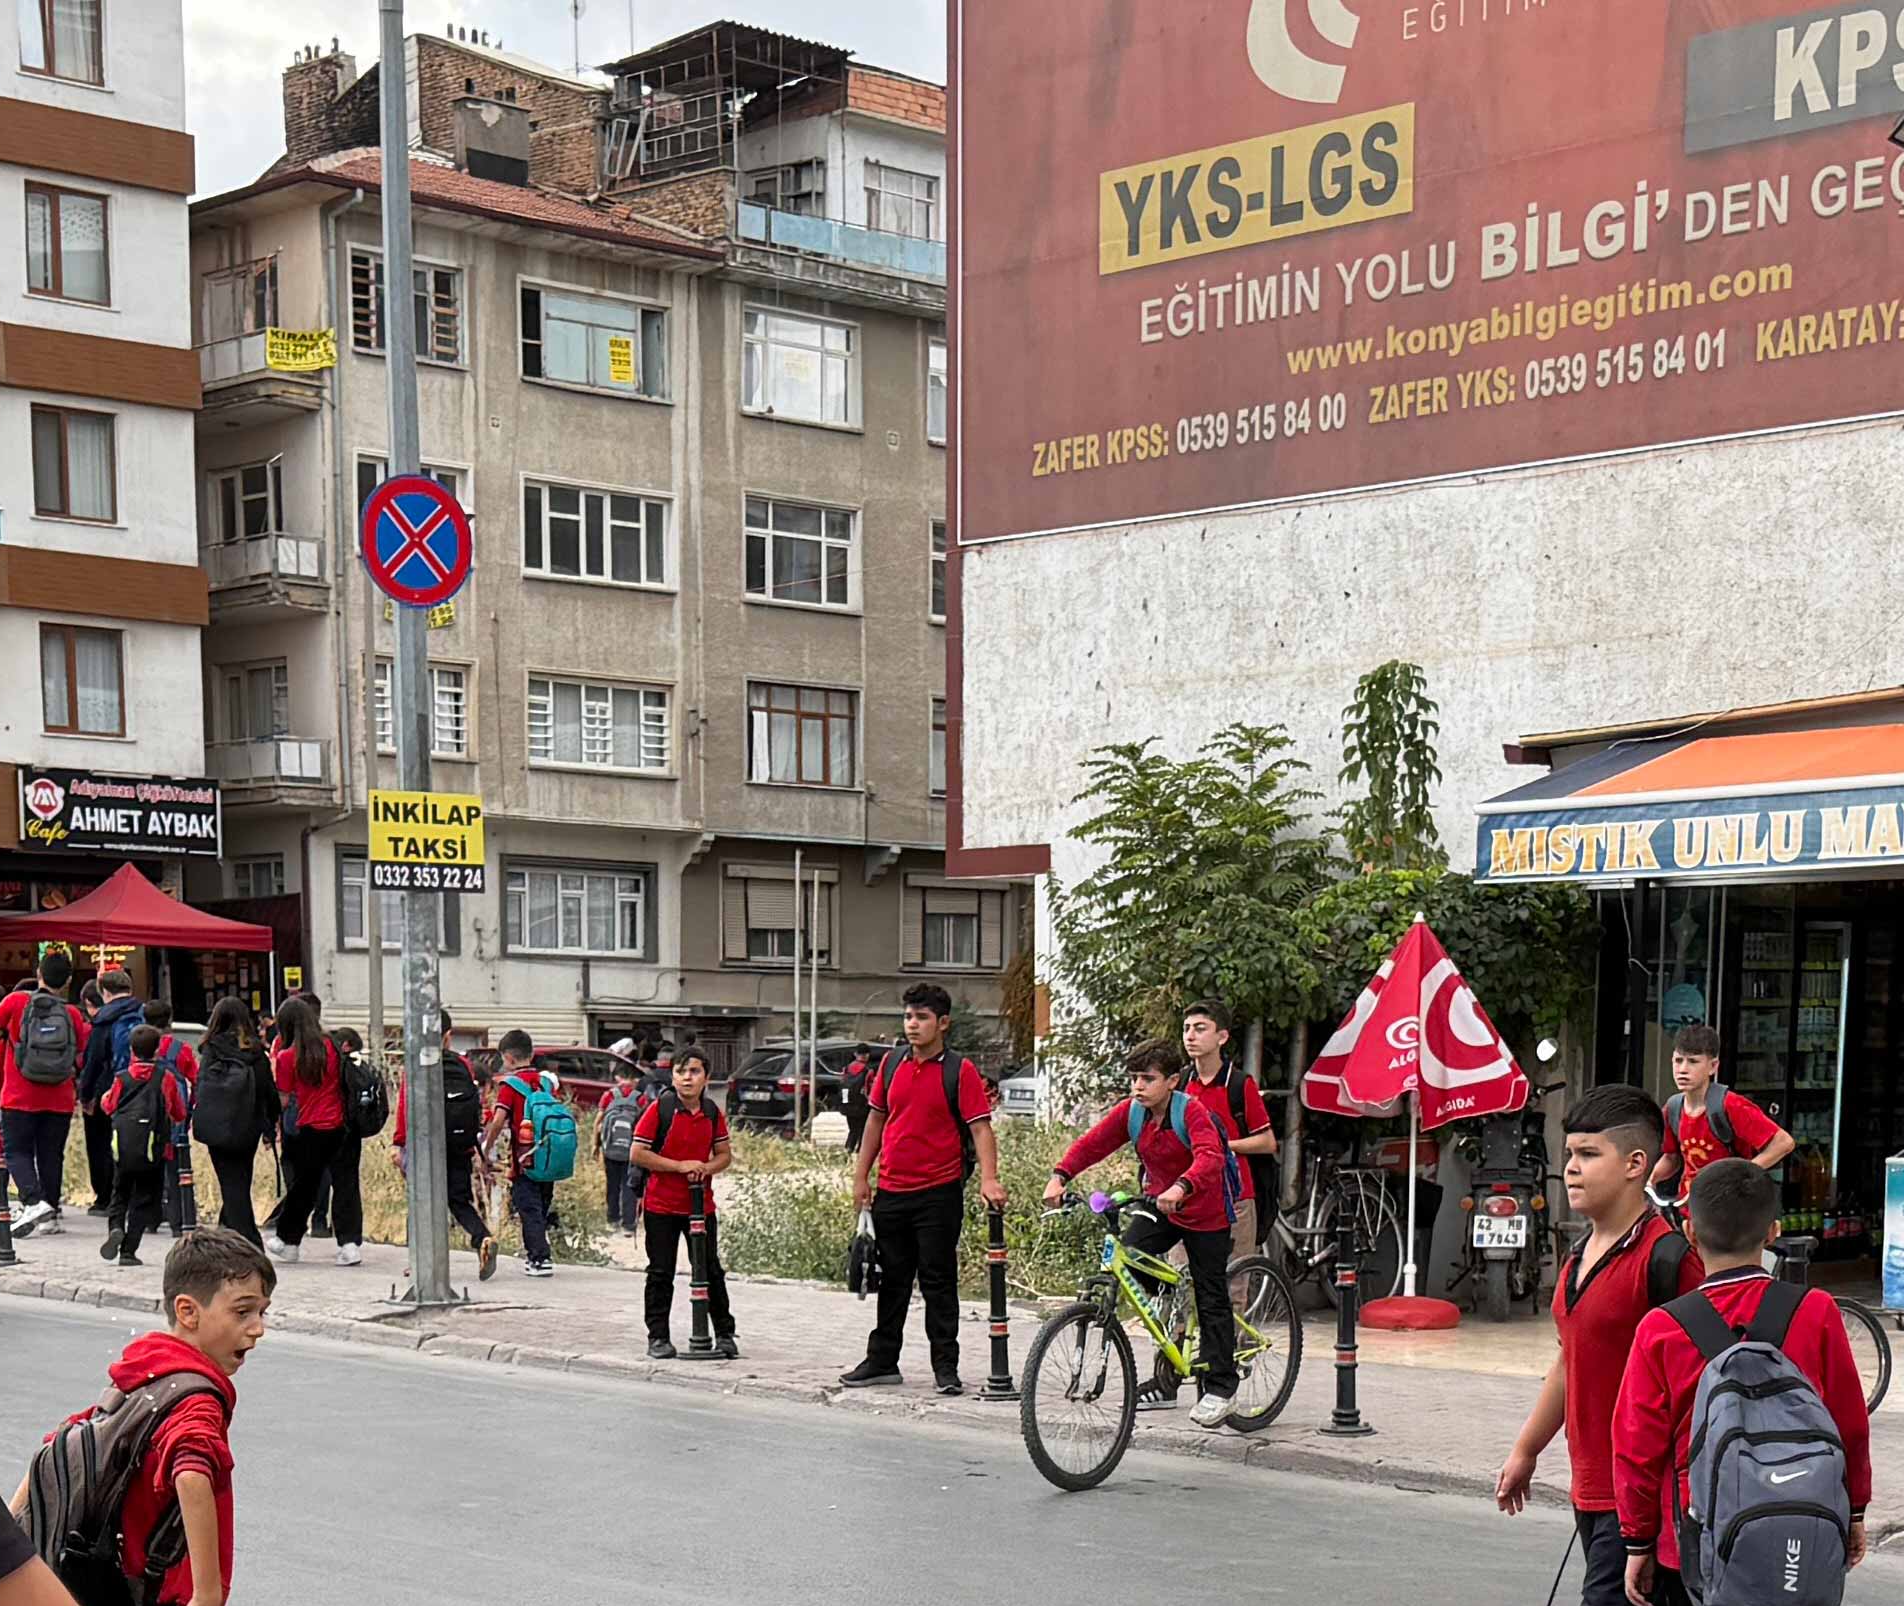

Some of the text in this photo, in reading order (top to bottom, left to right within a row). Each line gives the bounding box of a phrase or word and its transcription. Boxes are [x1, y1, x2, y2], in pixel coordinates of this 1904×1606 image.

[1114, 121, 1400, 257] YKS-LGS
[1139, 261, 1321, 344] EĞİTİMİN
[1335, 240, 1457, 306] YOLU
[1286, 263, 1793, 375] www.konyabilgiegitim.com
[1368, 328, 1727, 425] ZAFER YKS: 0539 515 84 01
[1032, 392, 1347, 477] ZAFER KPSS: 0539 515 84 00
[25, 818, 70, 847] Cafe
[69, 806, 217, 839] AHMET AYBAK
[372, 795, 481, 827] İNKİLAP
[388, 834, 467, 861] TAKSİ
[1487, 818, 1666, 879] MISTIK
[1671, 809, 1809, 872] UNLU
[374, 864, 482, 889] 0332 353 22 24
[1477, 1217, 1493, 1230] 42
[1783, 1537, 1802, 1593] NIKE
